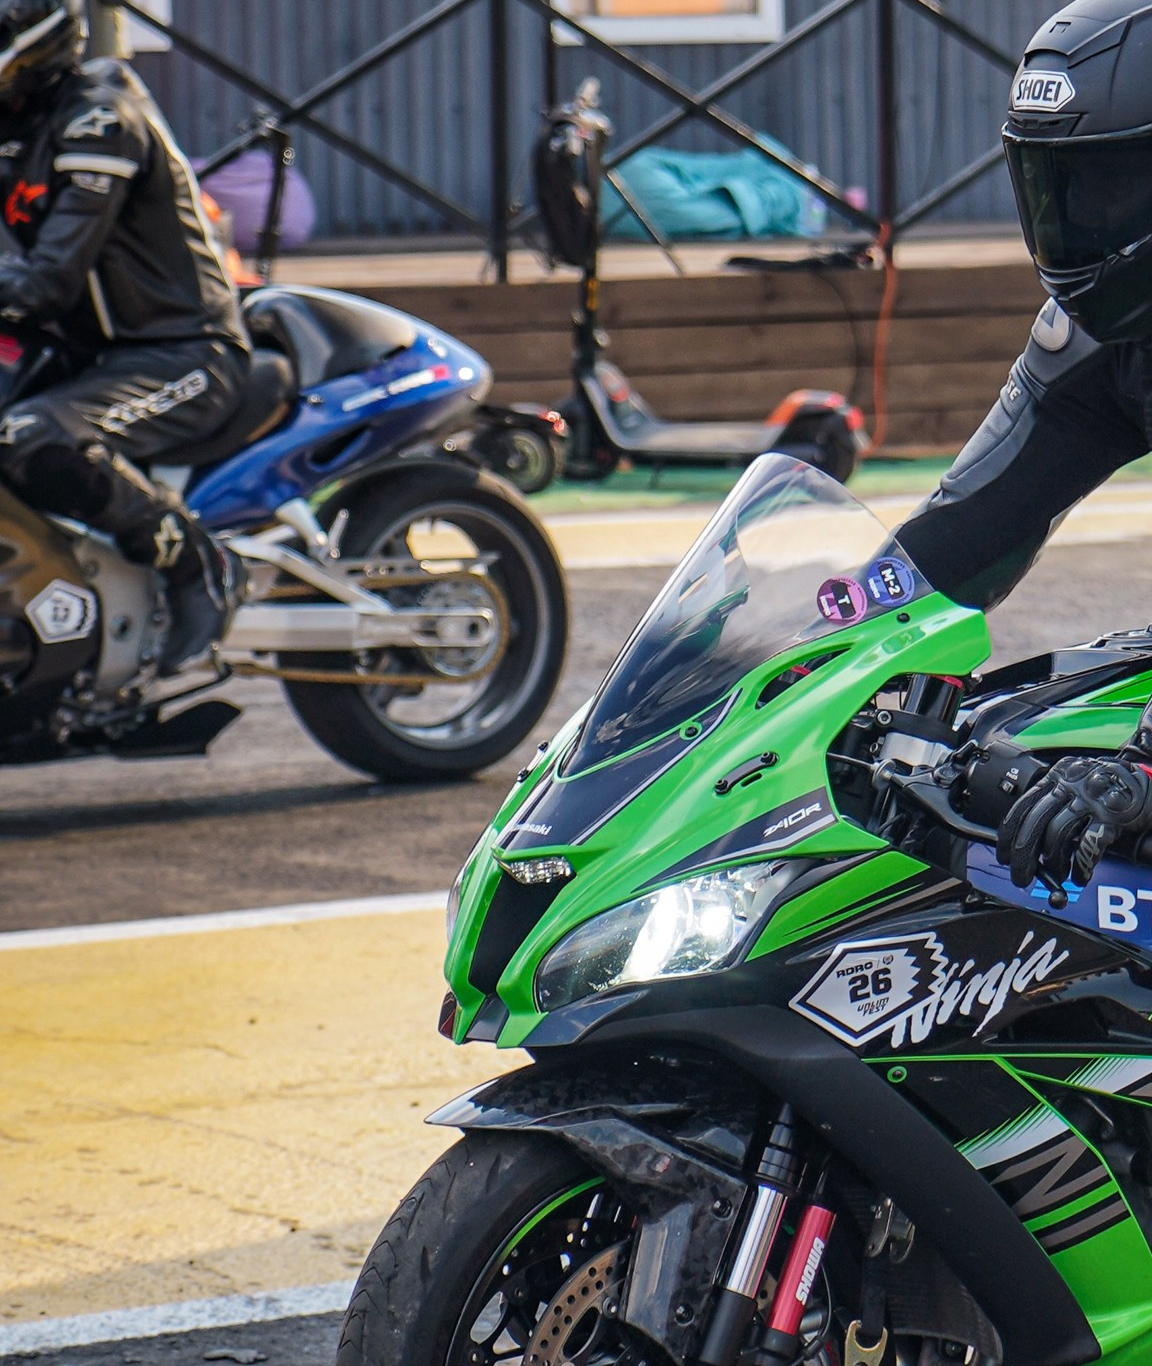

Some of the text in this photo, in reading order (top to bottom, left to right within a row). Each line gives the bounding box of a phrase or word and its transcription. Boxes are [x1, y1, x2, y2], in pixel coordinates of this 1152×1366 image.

[1016, 75, 1063, 103] SHOEI
[848, 967, 892, 1004] 26
[795, 1236, 826, 1306] SHOWA
